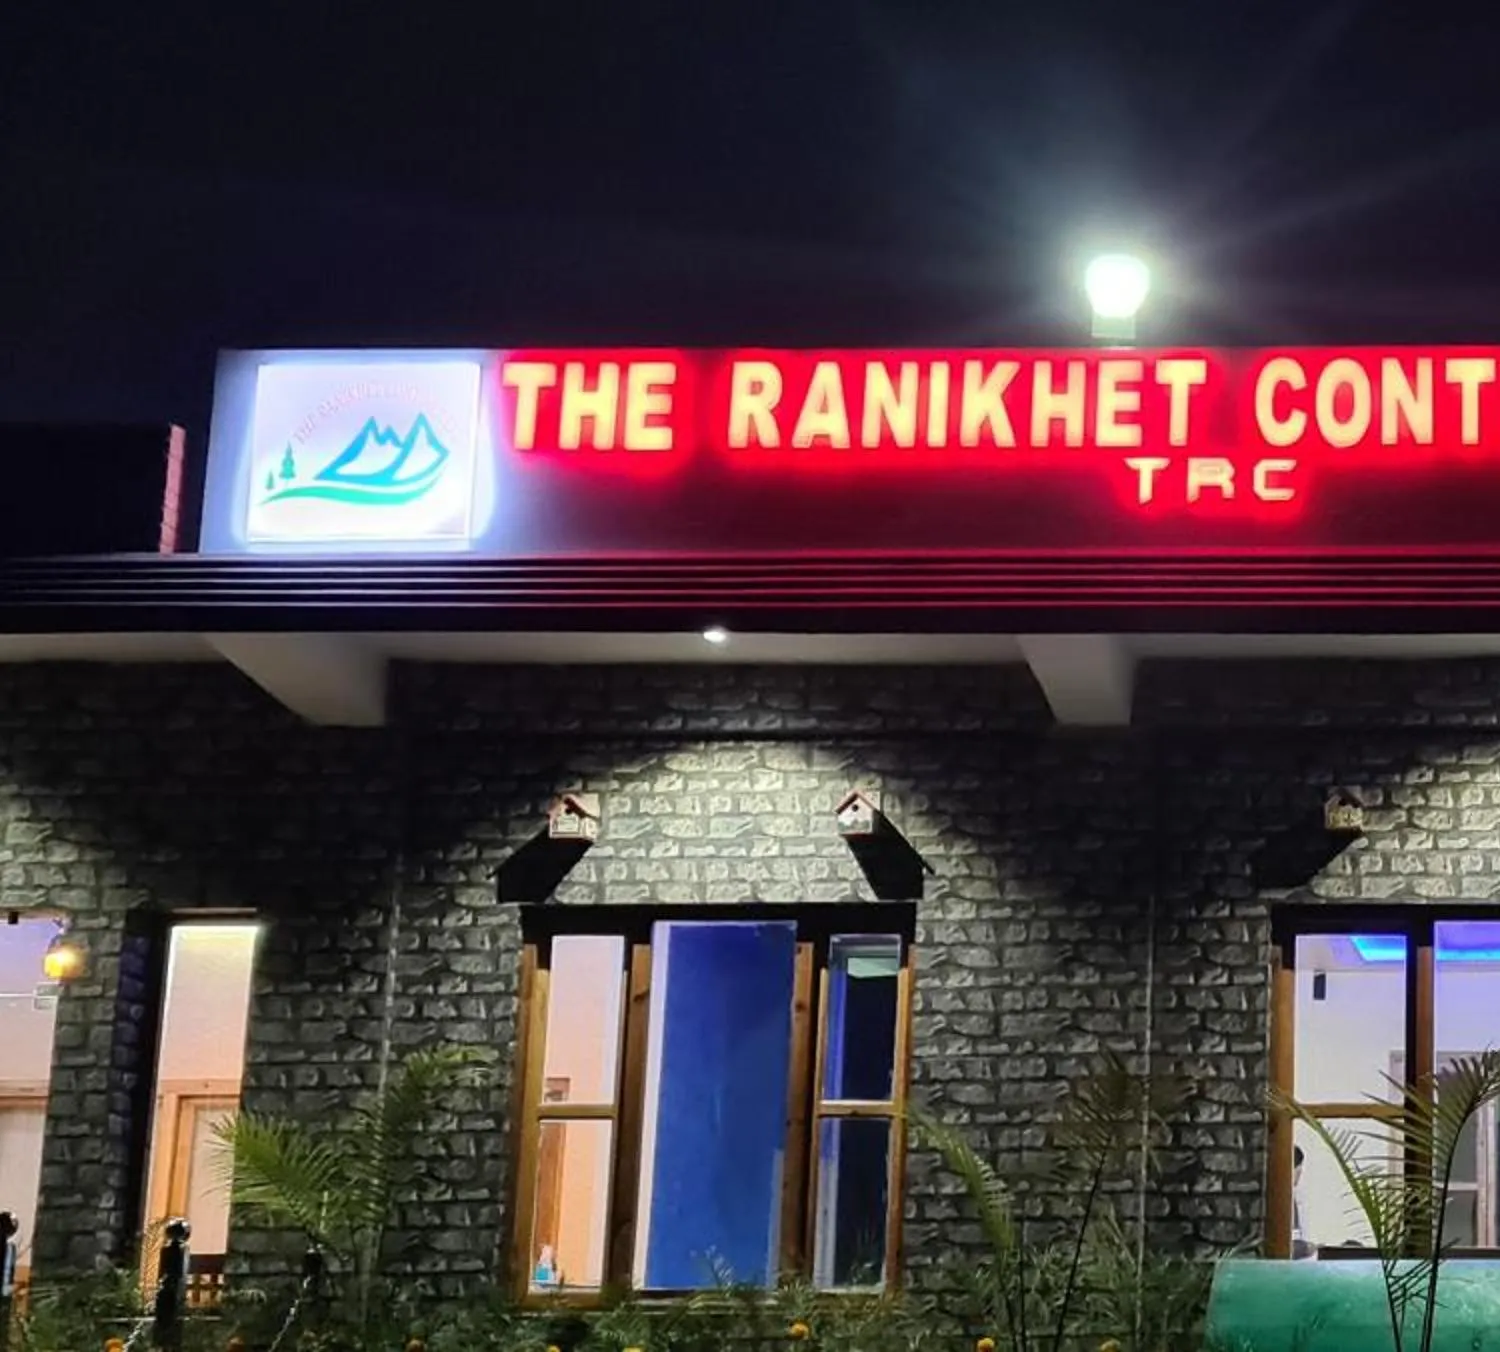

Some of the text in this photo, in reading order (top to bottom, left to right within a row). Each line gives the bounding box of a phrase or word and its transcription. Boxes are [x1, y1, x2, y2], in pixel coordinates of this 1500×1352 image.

[503, 362, 677, 451] THE
[728, 360, 1208, 449] RANIKHET
[1126, 457, 1297, 504] TRC
